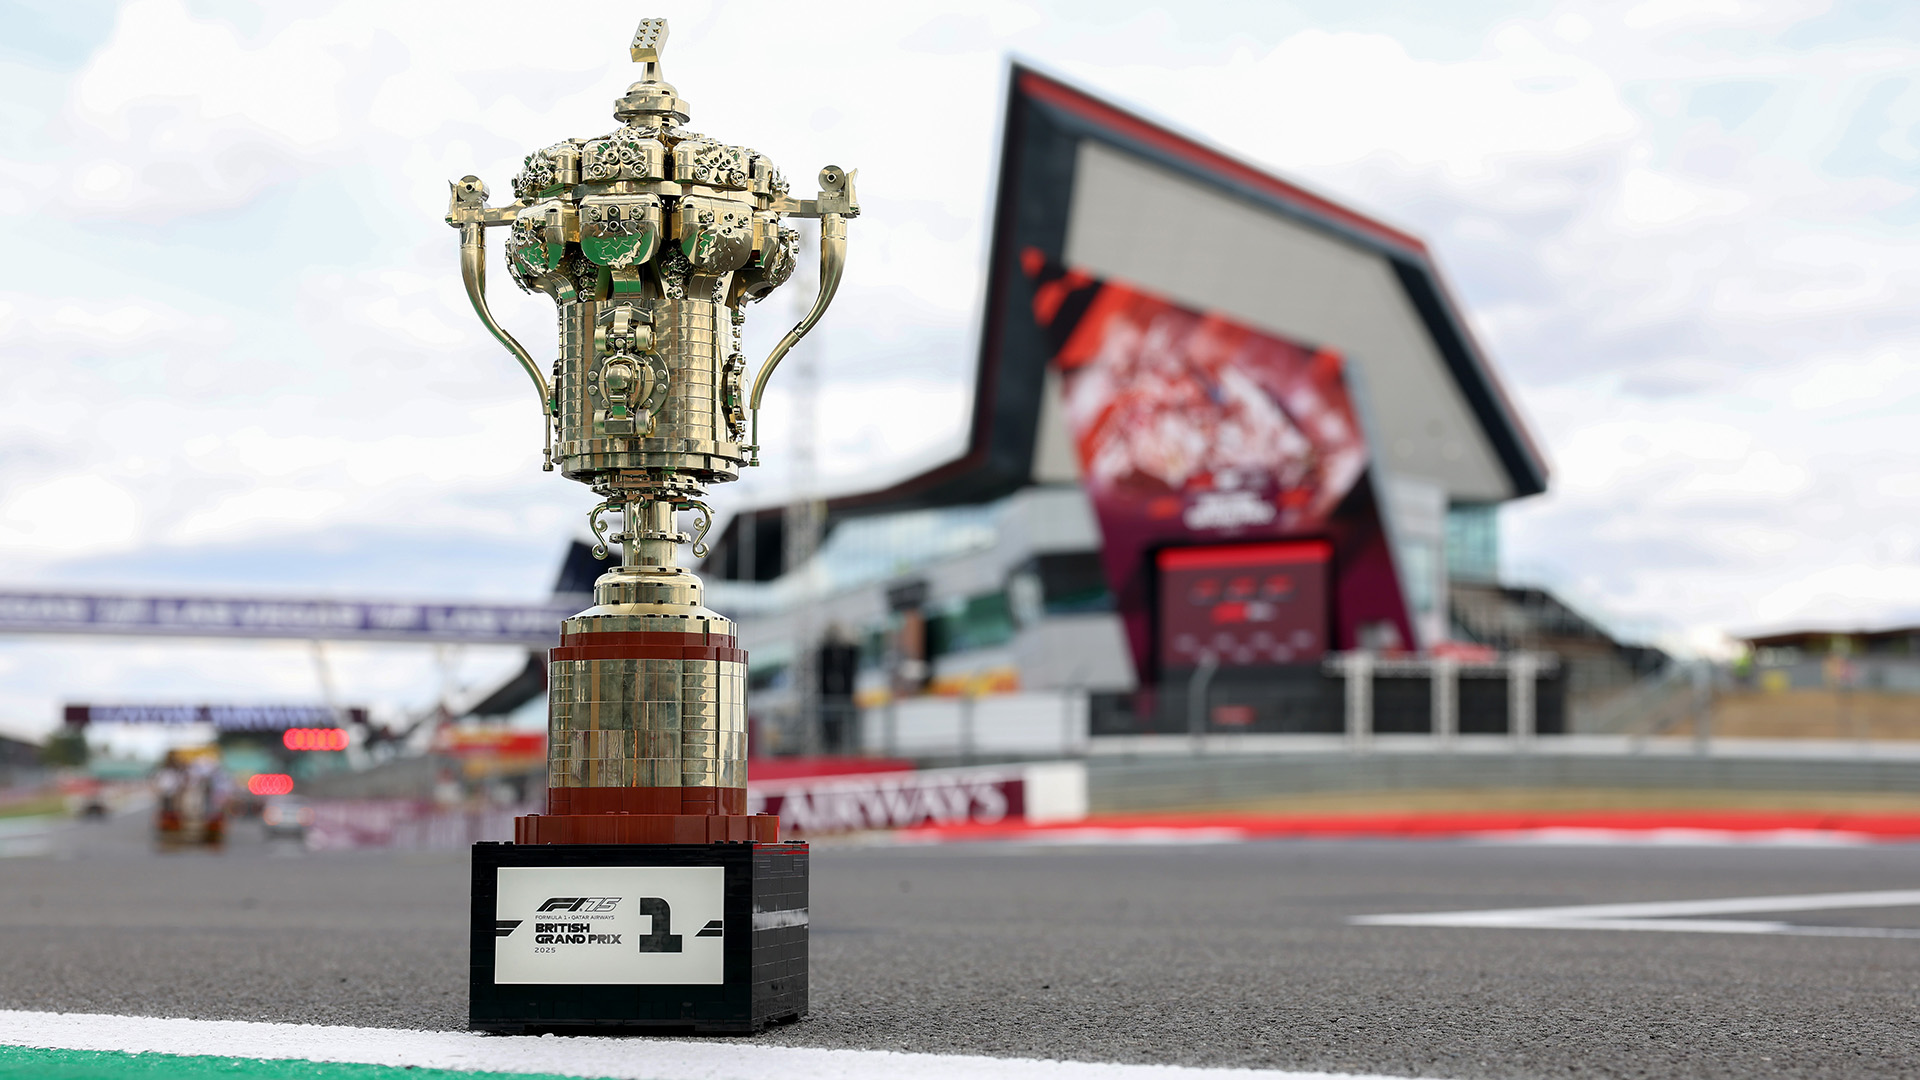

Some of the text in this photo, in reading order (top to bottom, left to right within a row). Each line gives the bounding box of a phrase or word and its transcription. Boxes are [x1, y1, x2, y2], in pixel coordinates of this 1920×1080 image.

[779, 776, 1008, 829] AIRWAYS
[535, 923, 590, 933] BRITISH
[535, 934, 622, 944] GRAND PRIX
[639, 897, 683, 953] 1
